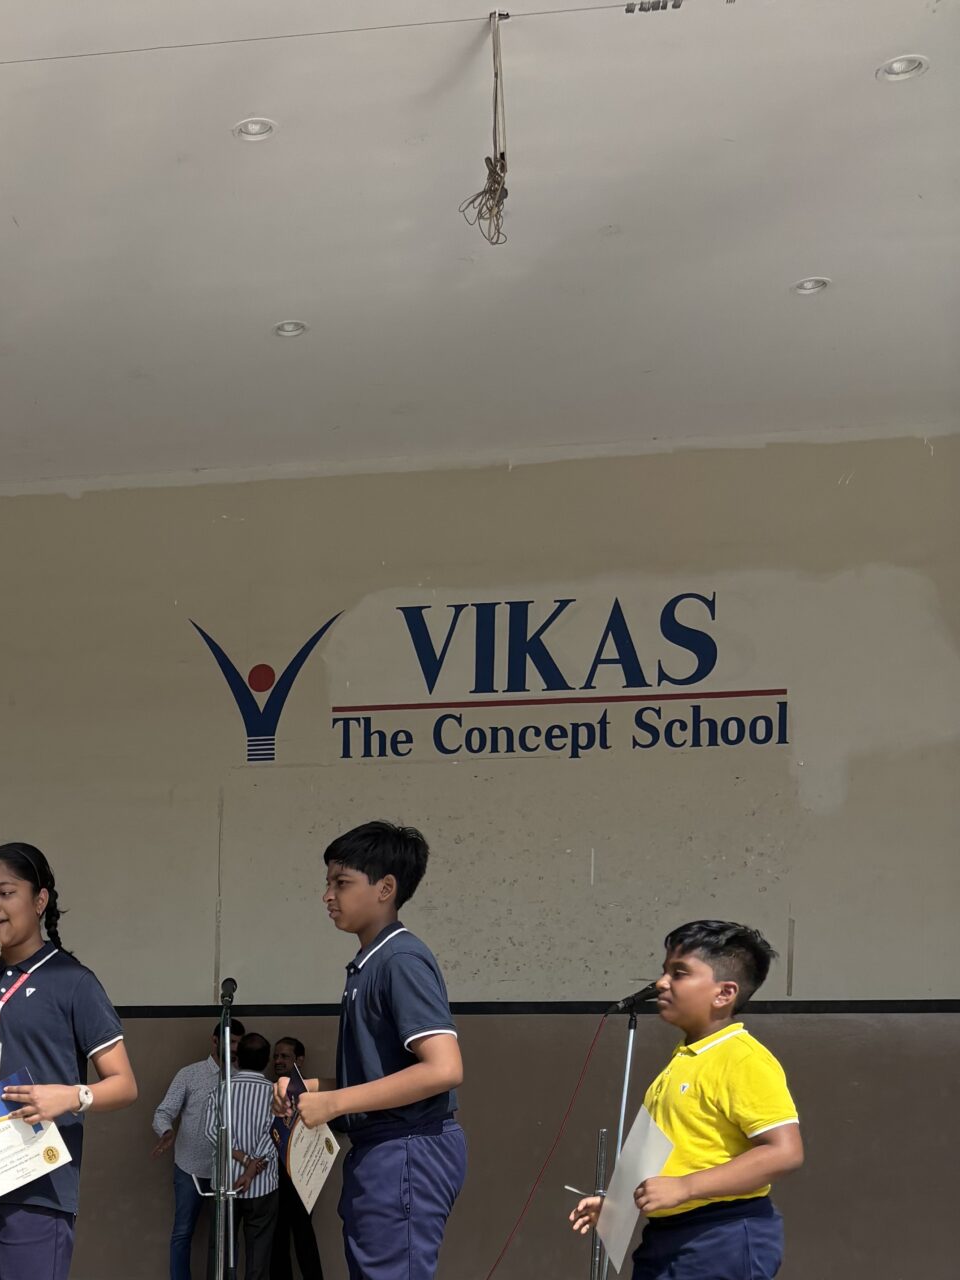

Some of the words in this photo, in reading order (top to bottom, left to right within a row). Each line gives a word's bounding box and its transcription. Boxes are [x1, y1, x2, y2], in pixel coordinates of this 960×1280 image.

[395, 591, 719, 696] VIKAS
[331, 715, 414, 759] The
[432, 708, 612, 759] Concept
[632, 702, 790, 750] School
